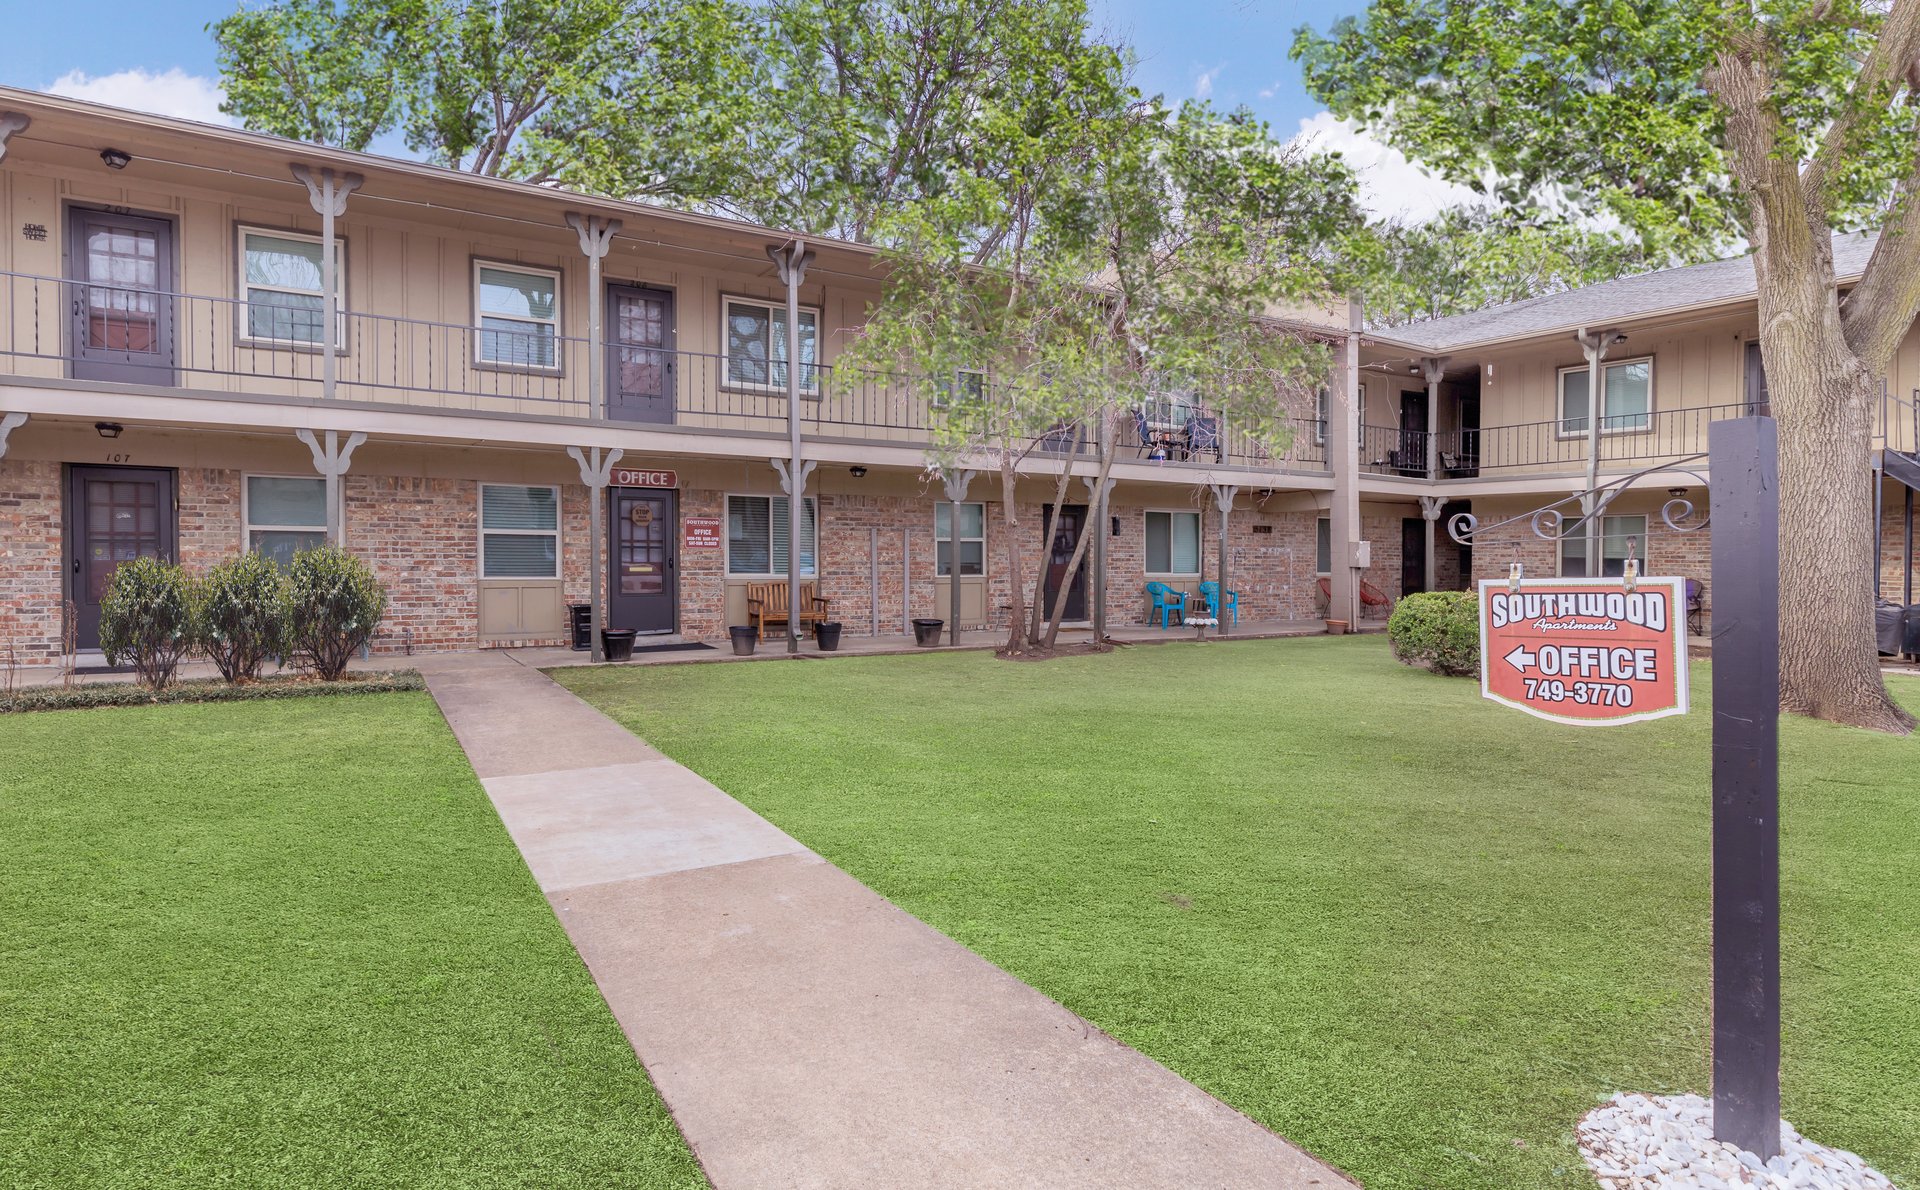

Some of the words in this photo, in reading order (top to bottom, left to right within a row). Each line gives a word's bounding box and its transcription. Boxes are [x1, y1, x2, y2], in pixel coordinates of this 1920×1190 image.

[104, 204, 131, 214] 207
[106, 454, 130, 462] 107
[618, 471, 668, 485] OFFICE
[1491, 593, 1666, 632] SOUTHWOOD
[1532, 618, 1617, 633] Apartments
[1538, 645, 1658, 682] OFFICE
[1523, 678, 1633, 707] 749-3770
